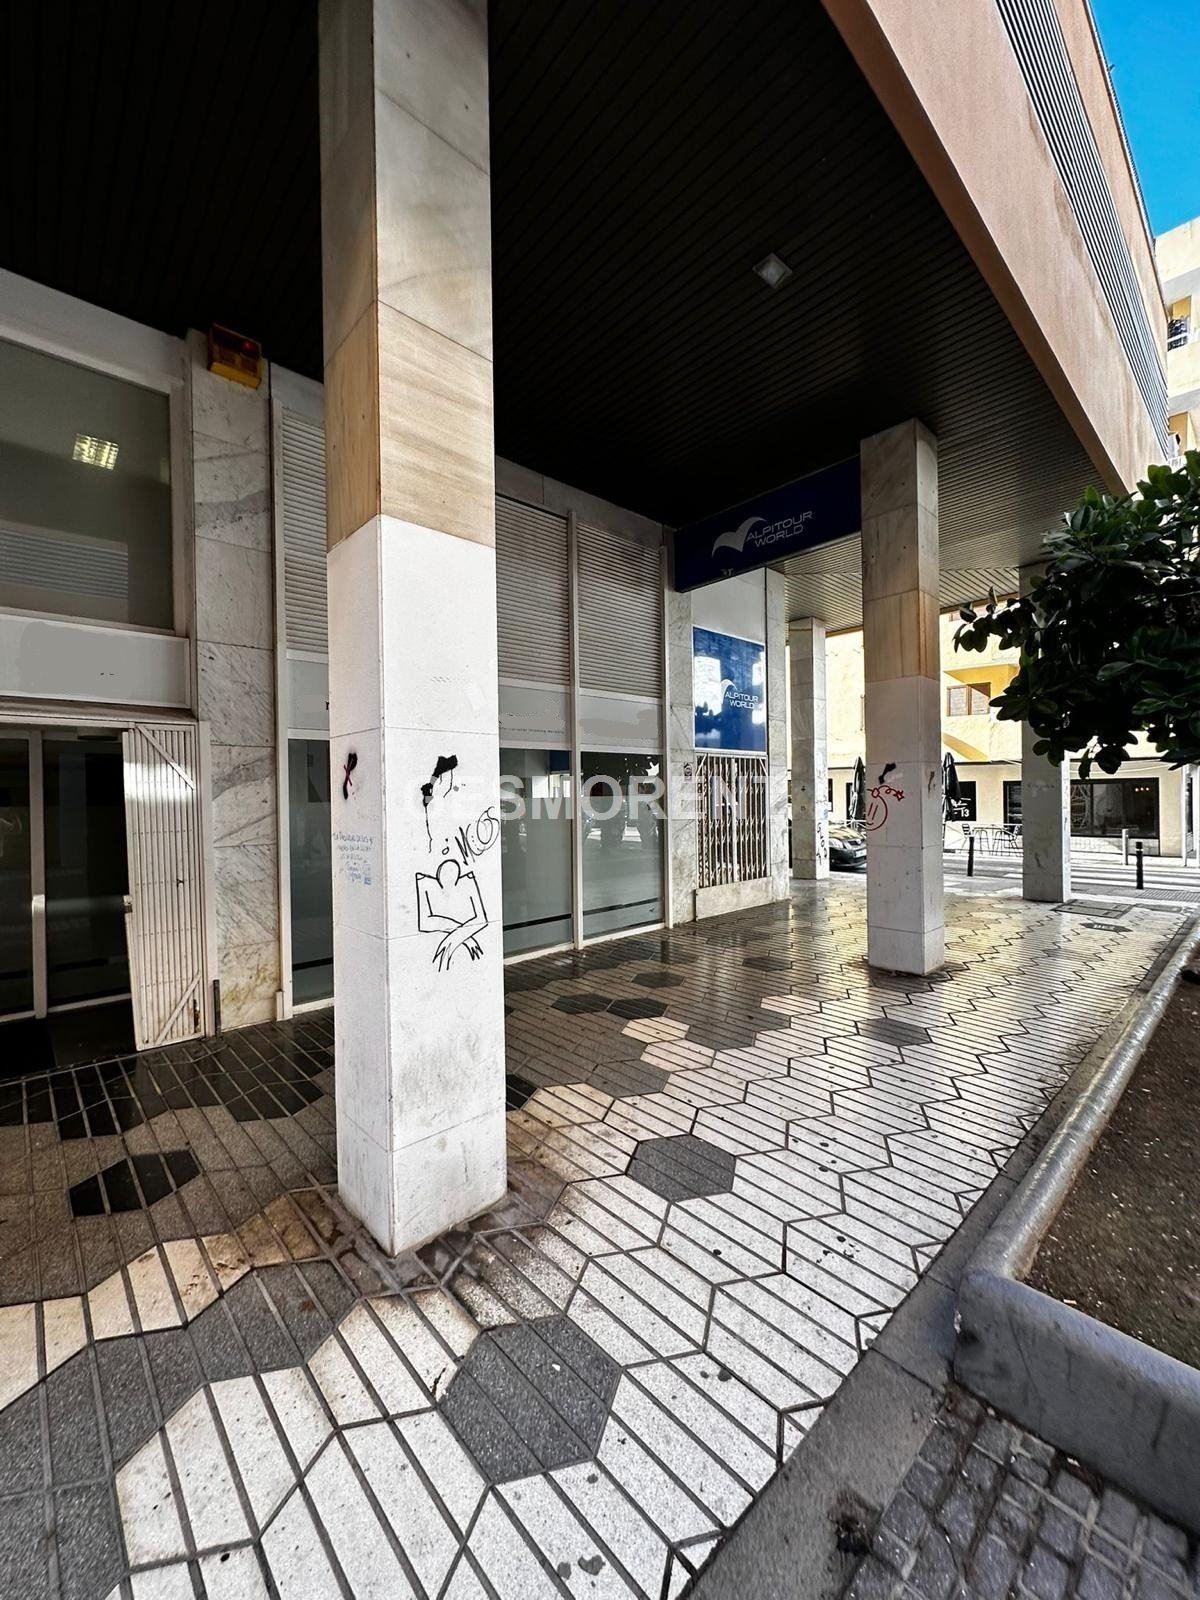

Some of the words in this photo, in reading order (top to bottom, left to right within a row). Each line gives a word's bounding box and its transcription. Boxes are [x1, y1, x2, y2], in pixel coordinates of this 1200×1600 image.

[747, 511, 813, 541] ALPITOUR
[754, 525, 804, 547] WORLD
[725, 692, 759, 702] ALPITOUR
[730, 700, 755, 709] WORLD
